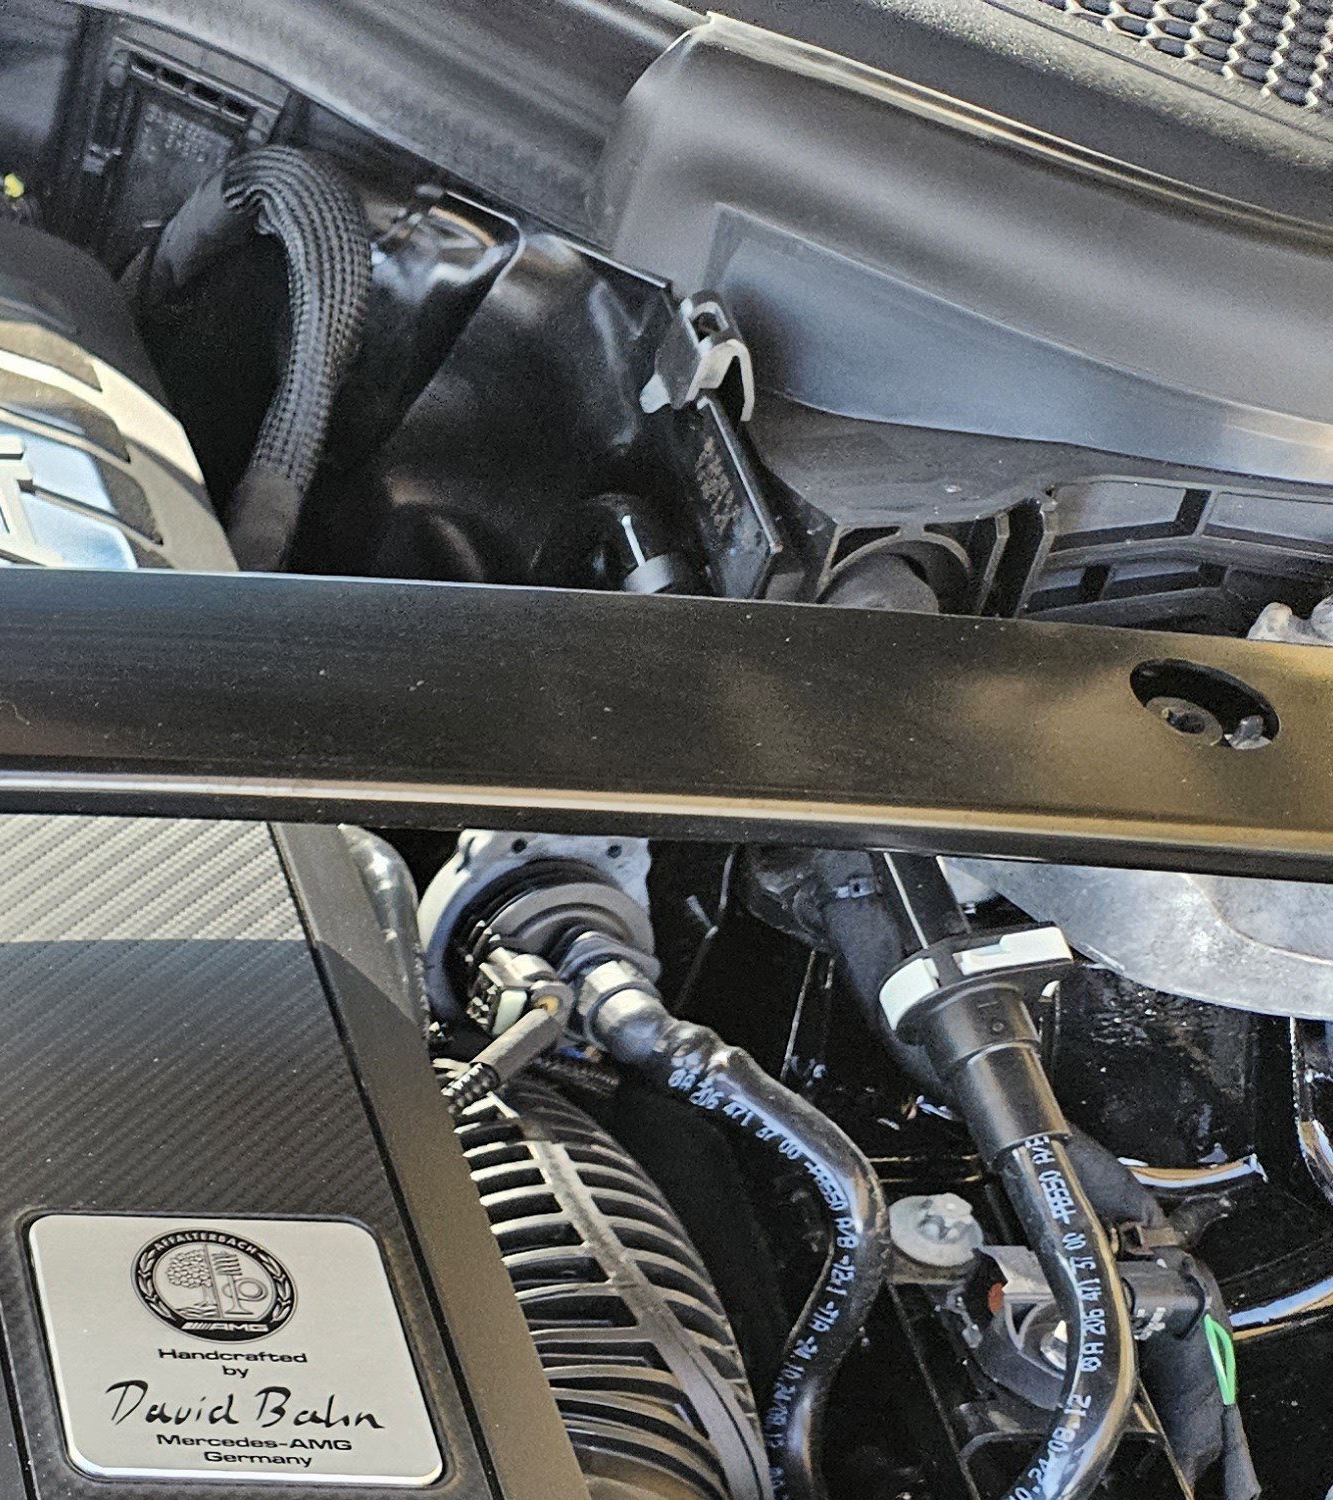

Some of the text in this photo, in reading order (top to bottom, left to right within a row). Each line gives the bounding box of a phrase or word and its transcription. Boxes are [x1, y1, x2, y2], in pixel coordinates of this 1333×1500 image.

[154, 1232, 256, 1254] AFFALTERBACH
[210, 1323, 269, 1332] AMG
[158, 1349, 308, 1363] Handcrafted
[222, 1365, 248, 1378] by
[105, 1379, 385, 1428] David Bahn
[156, 1434, 352, 1451] Mercedes-AMG
[204, 1451, 312, 1468] Germany
